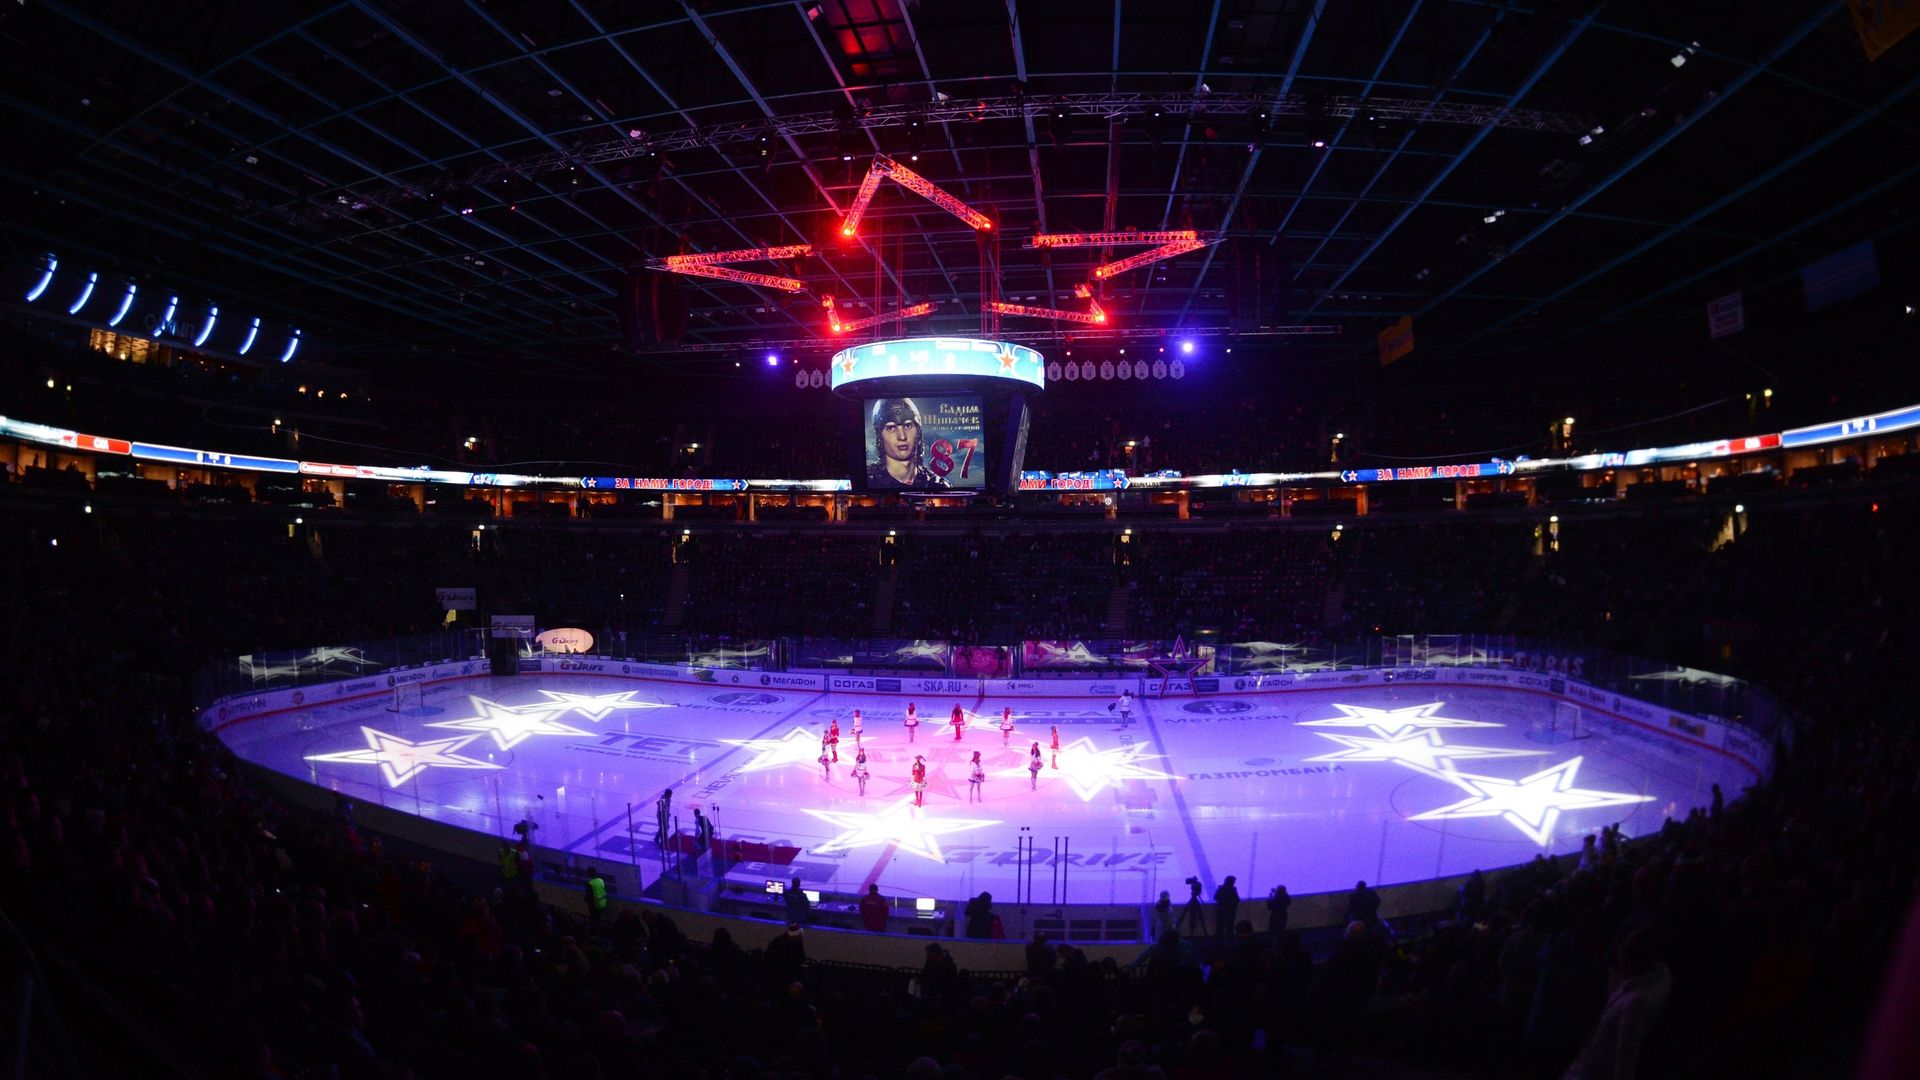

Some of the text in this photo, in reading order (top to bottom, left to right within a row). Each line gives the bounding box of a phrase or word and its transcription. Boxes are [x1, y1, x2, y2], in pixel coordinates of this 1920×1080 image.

[930, 438, 978, 479] 87
[1377, 464, 1480, 480] ЗА НАМИ ГОРОД!
[615, 478, 714, 490] ЗА НАМИ ГОРОД!
[1019, 479, 1094, 490] АМИ ГОРОД!
[1396, 671, 1436, 680] PEPSI
[834, 680, 874, 689] СОГАЗ
[924, 681, 961, 692] SKA.RU
[1518, 676, 1549, 688] СОГАЗ
[1188, 765, 1345, 780] ГАЗПРОМБАНК
